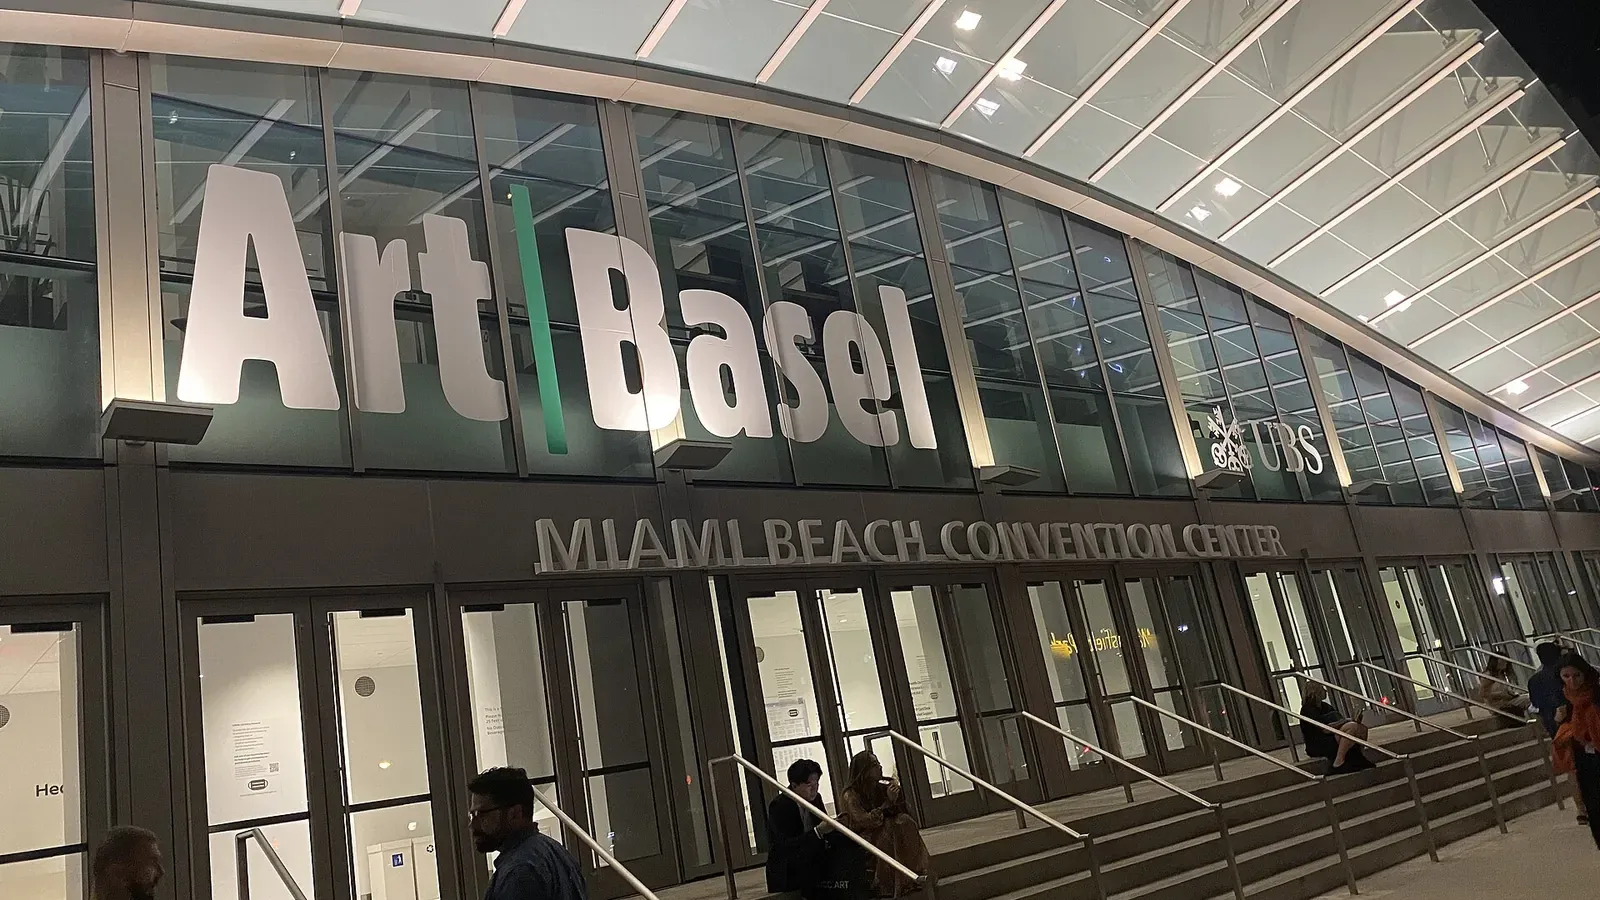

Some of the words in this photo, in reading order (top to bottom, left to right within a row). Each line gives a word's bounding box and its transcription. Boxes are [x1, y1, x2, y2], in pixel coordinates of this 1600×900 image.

[177, 164, 508, 422] Art
[566, 227, 937, 450] Basel
[1247, 420, 1324, 475] UBS
[535, 518, 742, 571] MIAMI
[763, 519, 926, 565] BEACH
[940, 520, 1178, 561] CONVENTION
[1183, 523, 1288, 556] CENTER
